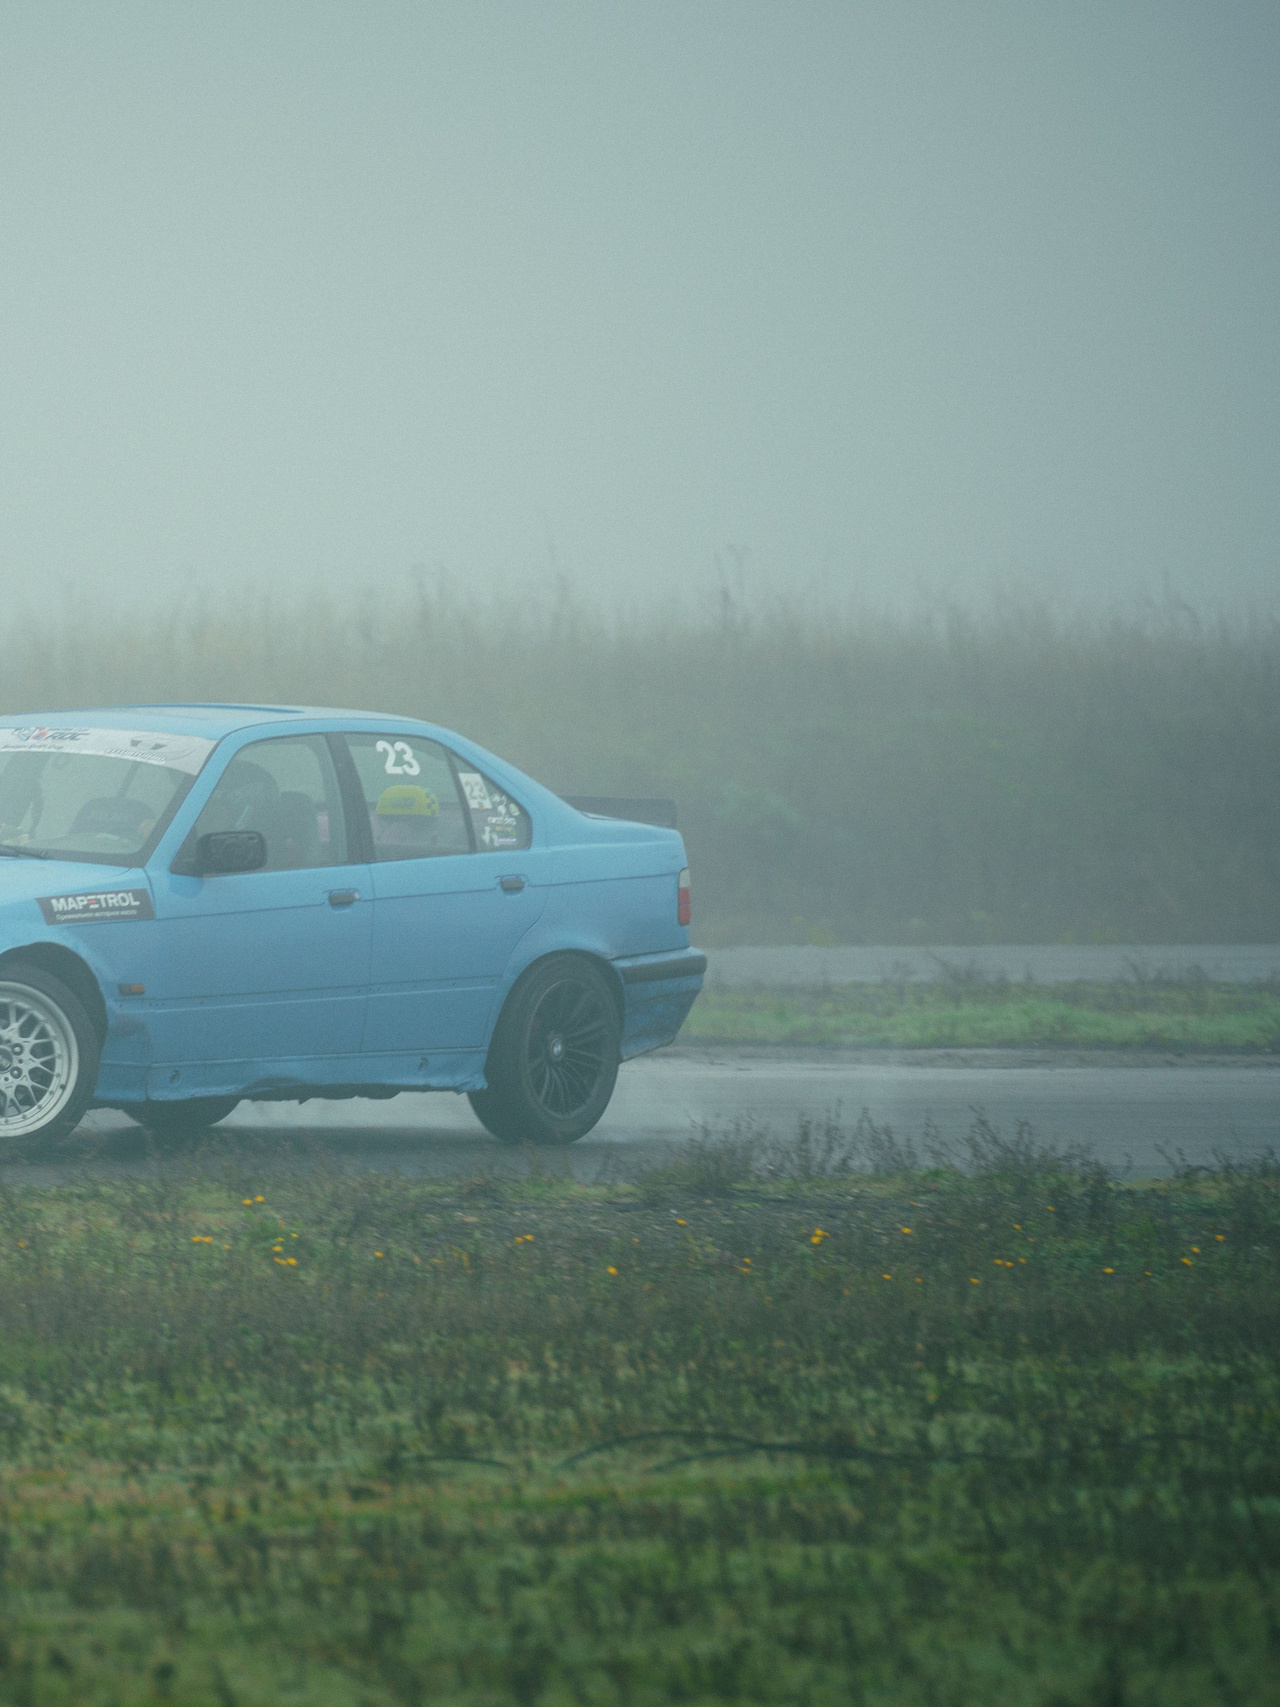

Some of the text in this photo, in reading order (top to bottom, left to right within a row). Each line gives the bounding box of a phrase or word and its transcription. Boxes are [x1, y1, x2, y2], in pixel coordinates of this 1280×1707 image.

[375, 740, 421, 776] 23
[465, 780, 487, 800] 23
[50, 892, 140, 912] MAPETROL
